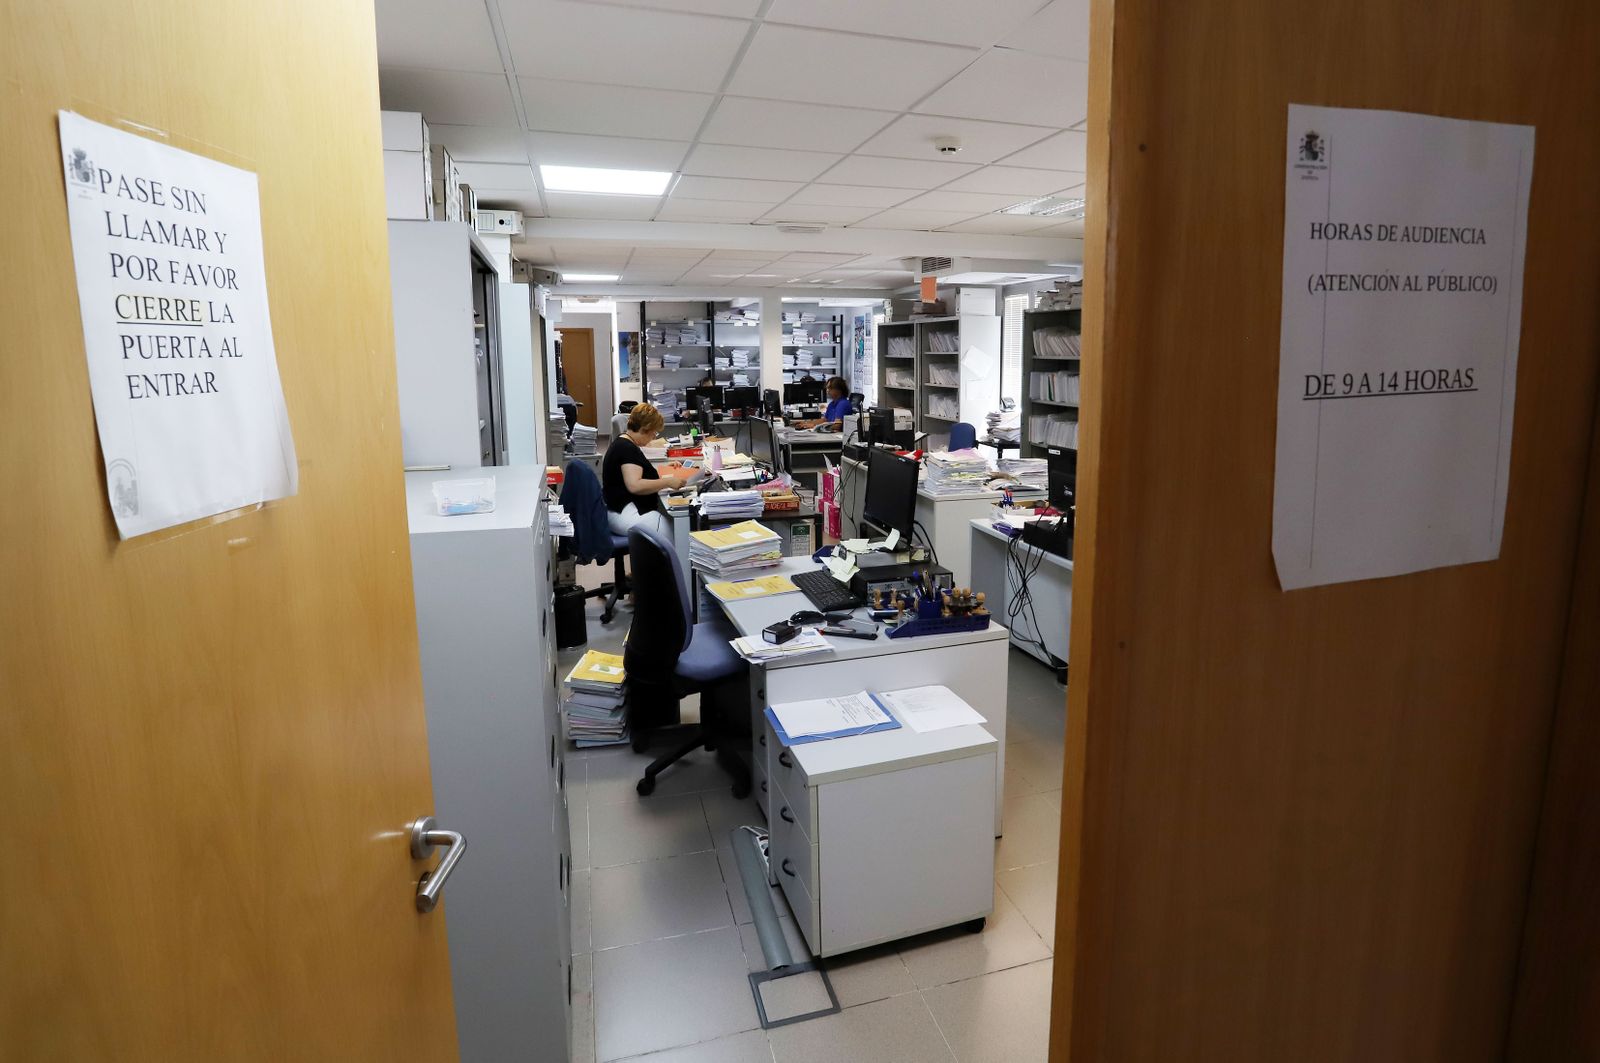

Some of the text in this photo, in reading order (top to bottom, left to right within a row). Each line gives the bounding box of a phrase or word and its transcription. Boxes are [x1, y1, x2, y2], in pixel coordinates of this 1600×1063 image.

[98, 168, 166, 207] PASE
[170, 186, 207, 215] SIN
[105, 209, 228, 255] LLAMAR Y
[1310, 222, 1487, 246] HORAS DE AUDIENCIA
[110, 253, 239, 291] POR FAVOR
[1402, 274, 1424, 293] AL
[1426, 269, 1498, 296] PÚBLICO)
[115, 294, 235, 324] CIERRE LA
[119, 333, 244, 361] PUERTA AL
[126, 371, 219, 400] ENTRAR
[1304, 367, 1474, 396] DE 9 A 14 HORAS
